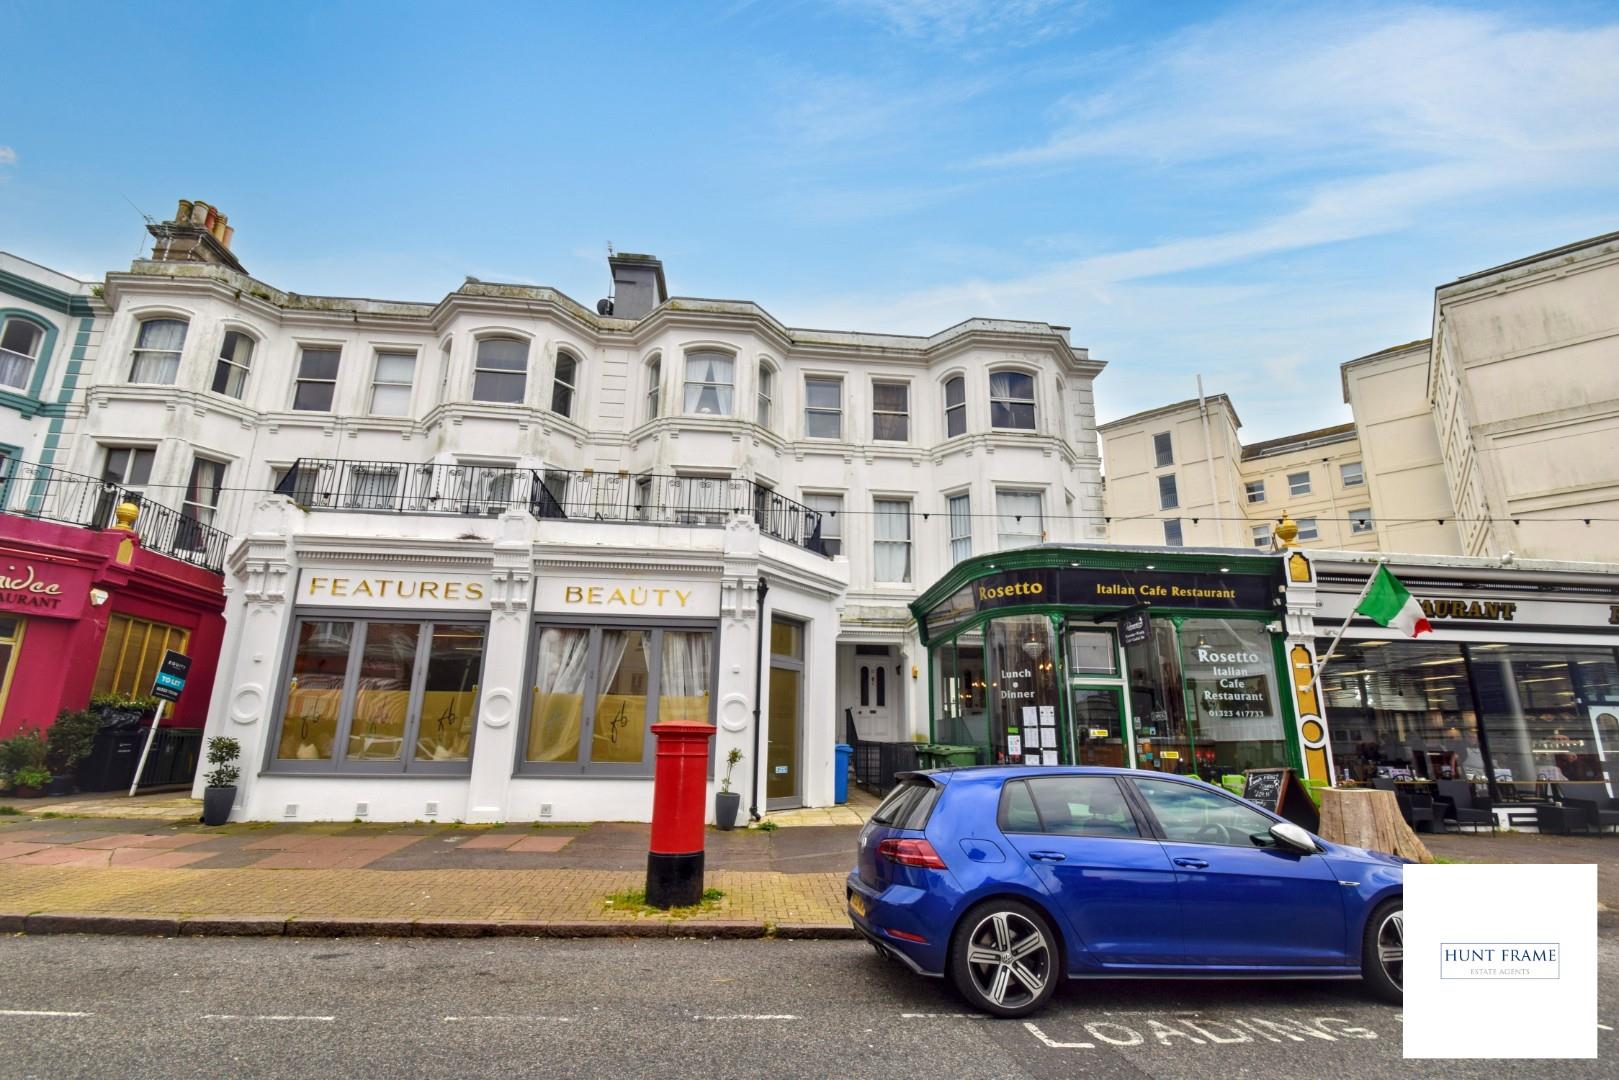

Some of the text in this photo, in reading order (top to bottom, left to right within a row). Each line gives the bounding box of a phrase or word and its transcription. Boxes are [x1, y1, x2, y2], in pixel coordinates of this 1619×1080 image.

[310, 577, 484, 600] FEATURES
[978, 581, 1043, 601] Rosetto
[1096, 583, 1236, 599] Italian Cafe Restaurant
[565, 586, 692, 607] BEAUTY
[1415, 599, 1516, 621] AURANT
[1197, 648, 1259, 663] Rosetto
[1001, 668, 1032, 679] Lunch
[1212, 665, 1248, 676] Italian
[161, 675, 181, 687] TO LET
[1219, 678, 1246, 689] Cafe
[1001, 690, 1036, 699] Dinner
[1203, 690, 1264, 701] Restaurant
[1208, 709, 1265, 718] 01323 417733
[1023, 1016, 1378, 1049] LOADING
